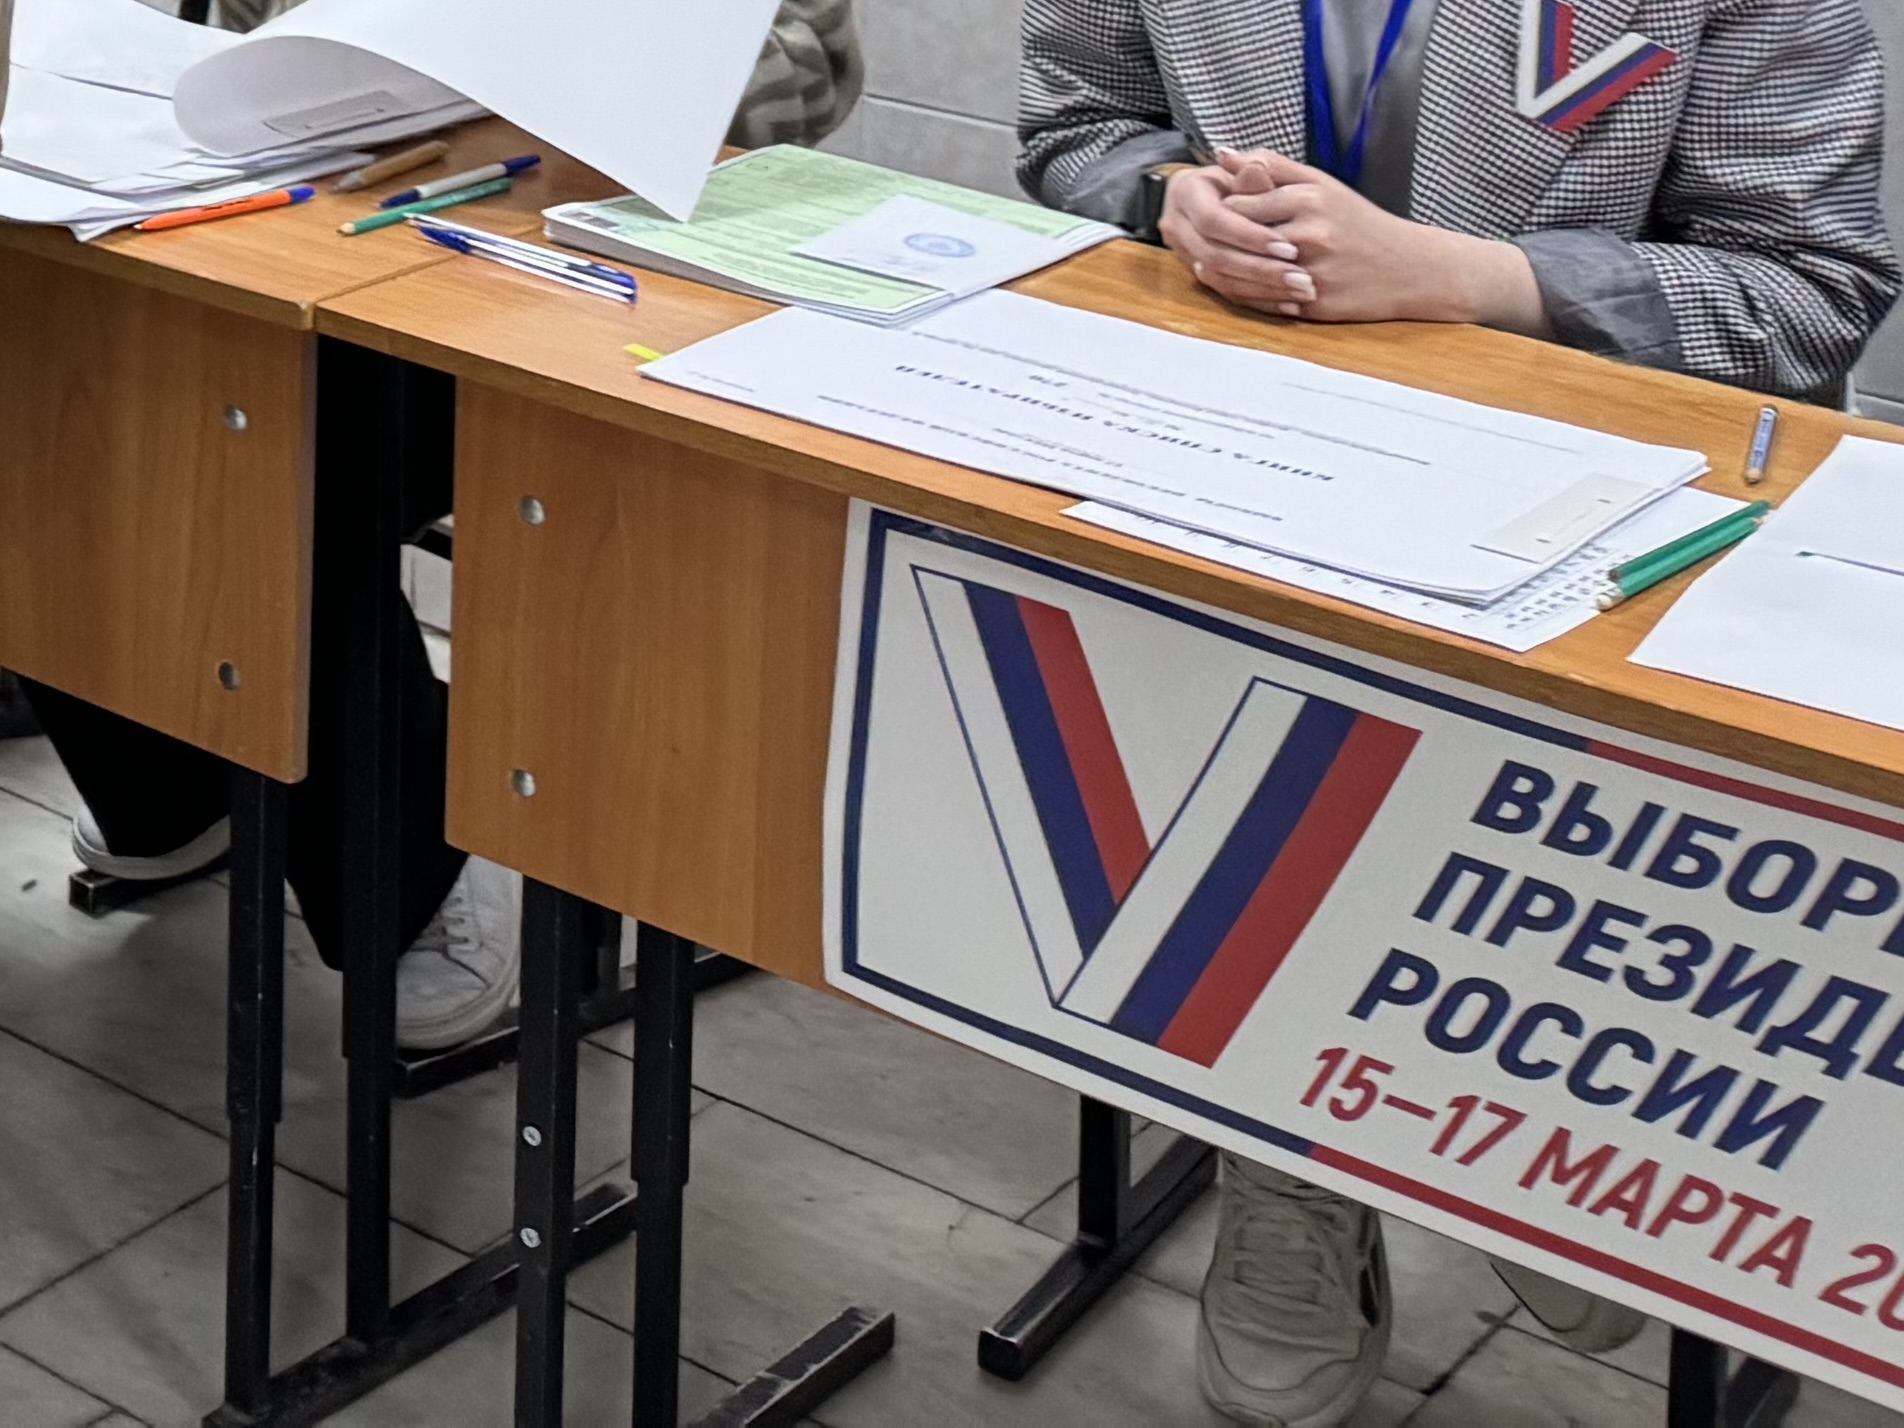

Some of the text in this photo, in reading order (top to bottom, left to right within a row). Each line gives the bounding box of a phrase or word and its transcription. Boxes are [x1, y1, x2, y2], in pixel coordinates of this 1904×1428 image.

[1469, 758, 1904, 958] ВЫБОР
[1346, 946, 1829, 1173] РОССИИ
[1517, 1125, 1815, 1289] МАРТА
